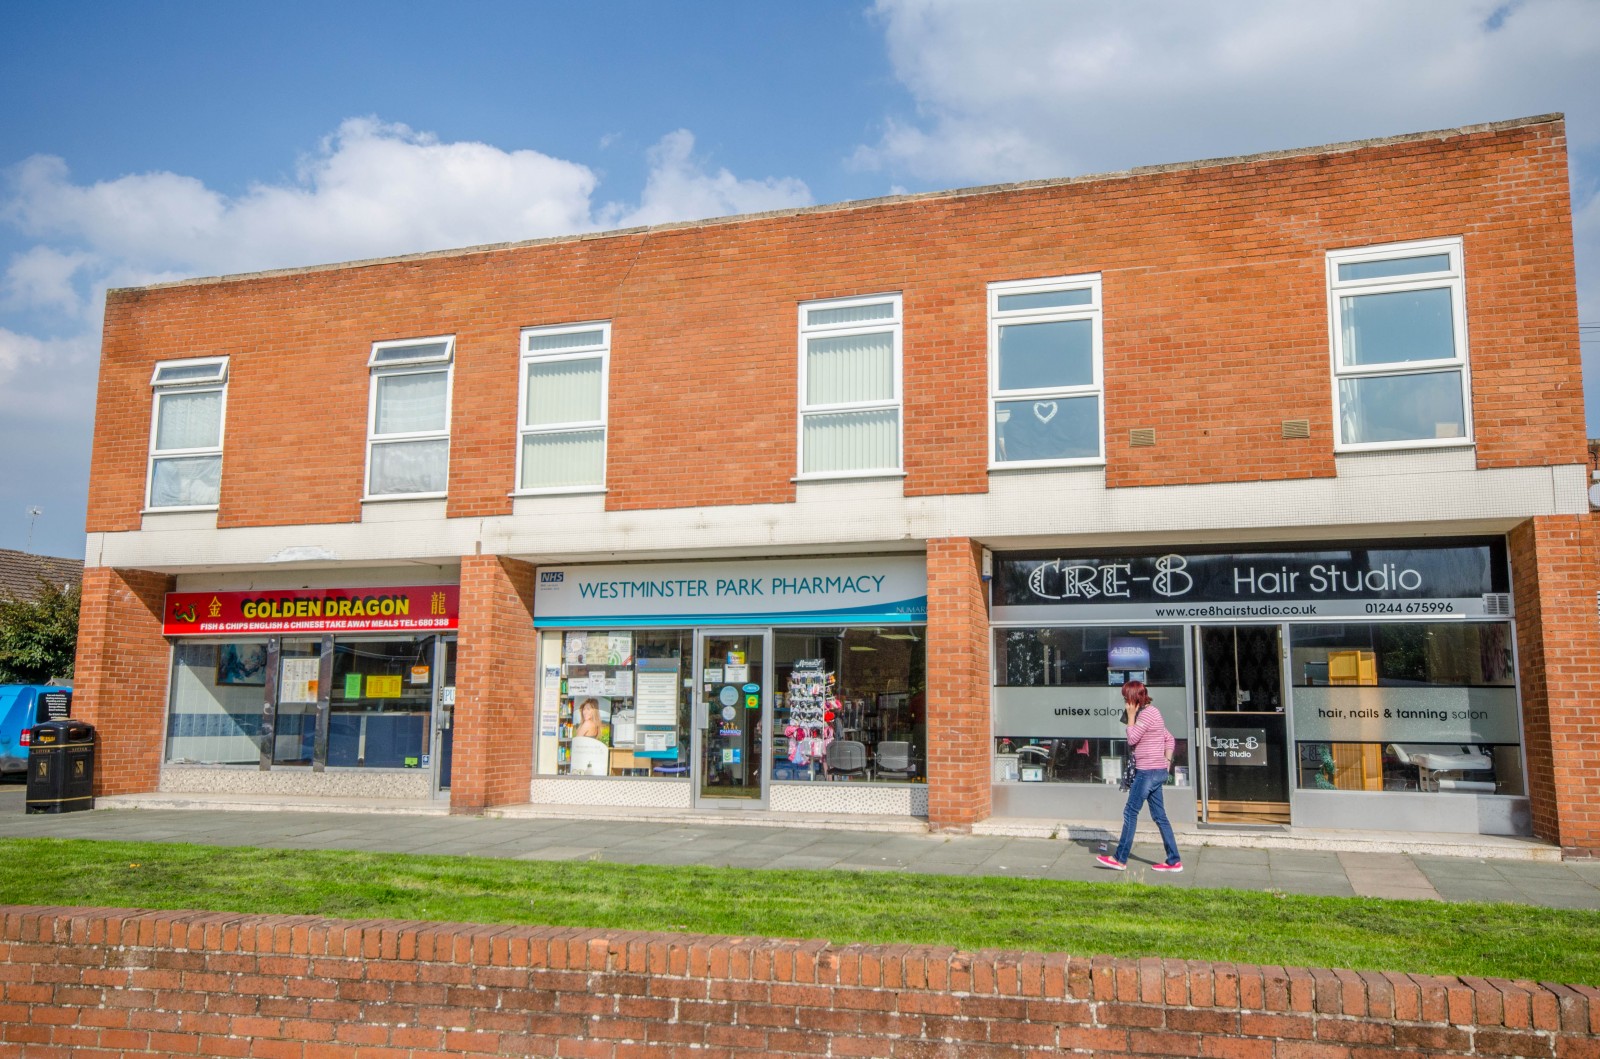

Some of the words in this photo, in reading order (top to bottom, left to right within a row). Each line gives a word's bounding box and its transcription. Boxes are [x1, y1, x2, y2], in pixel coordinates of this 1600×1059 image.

[541, 572, 564, 582] NHS
[1233, 565, 1300, 595] Hair
[1308, 562, 1423, 593] Studio
[578, 580, 709, 599] WESTMINSTER
[716, 578, 764, 596] PARK
[771, 575, 886, 595] PHARMACY
[207, 595, 223, 618] 金
[243, 600, 321, 619] GOLDEN
[325, 598, 410, 617] DRAGON
[896, 606, 927, 614] NUMAR
[1155, 603, 1318, 617] www.cre8hairstudio.co.uk
[1365, 602, 1403, 614] 01244
[1405, 602, 1454, 613] 675996
[200, 622, 218, 630] FISH
[219, 622, 225, 630] &
[225, 622, 249, 630] CHIPS
[249, 621, 283, 629] ENGLISH
[284, 621, 290, 629] &
[290, 620, 325, 629] CHINESE
[325, 620, 346, 628] TAKE
[347, 620, 371, 628] AWAY
[372, 619, 399, 627] MEALS
[399, 619, 418, 627] TEL:
[1054, 706, 1091, 716] unisex
[1318, 708, 1347, 719] hair,
[1350, 708, 1379, 719] nails
[1383, 709, 1393, 719] &
[1396, 708, 1448, 722] tanning
[1451, 709, 1489, 720] salon
[1213, 750, 1227, 758] Hair
[1229, 750, 1252, 758] Studio
